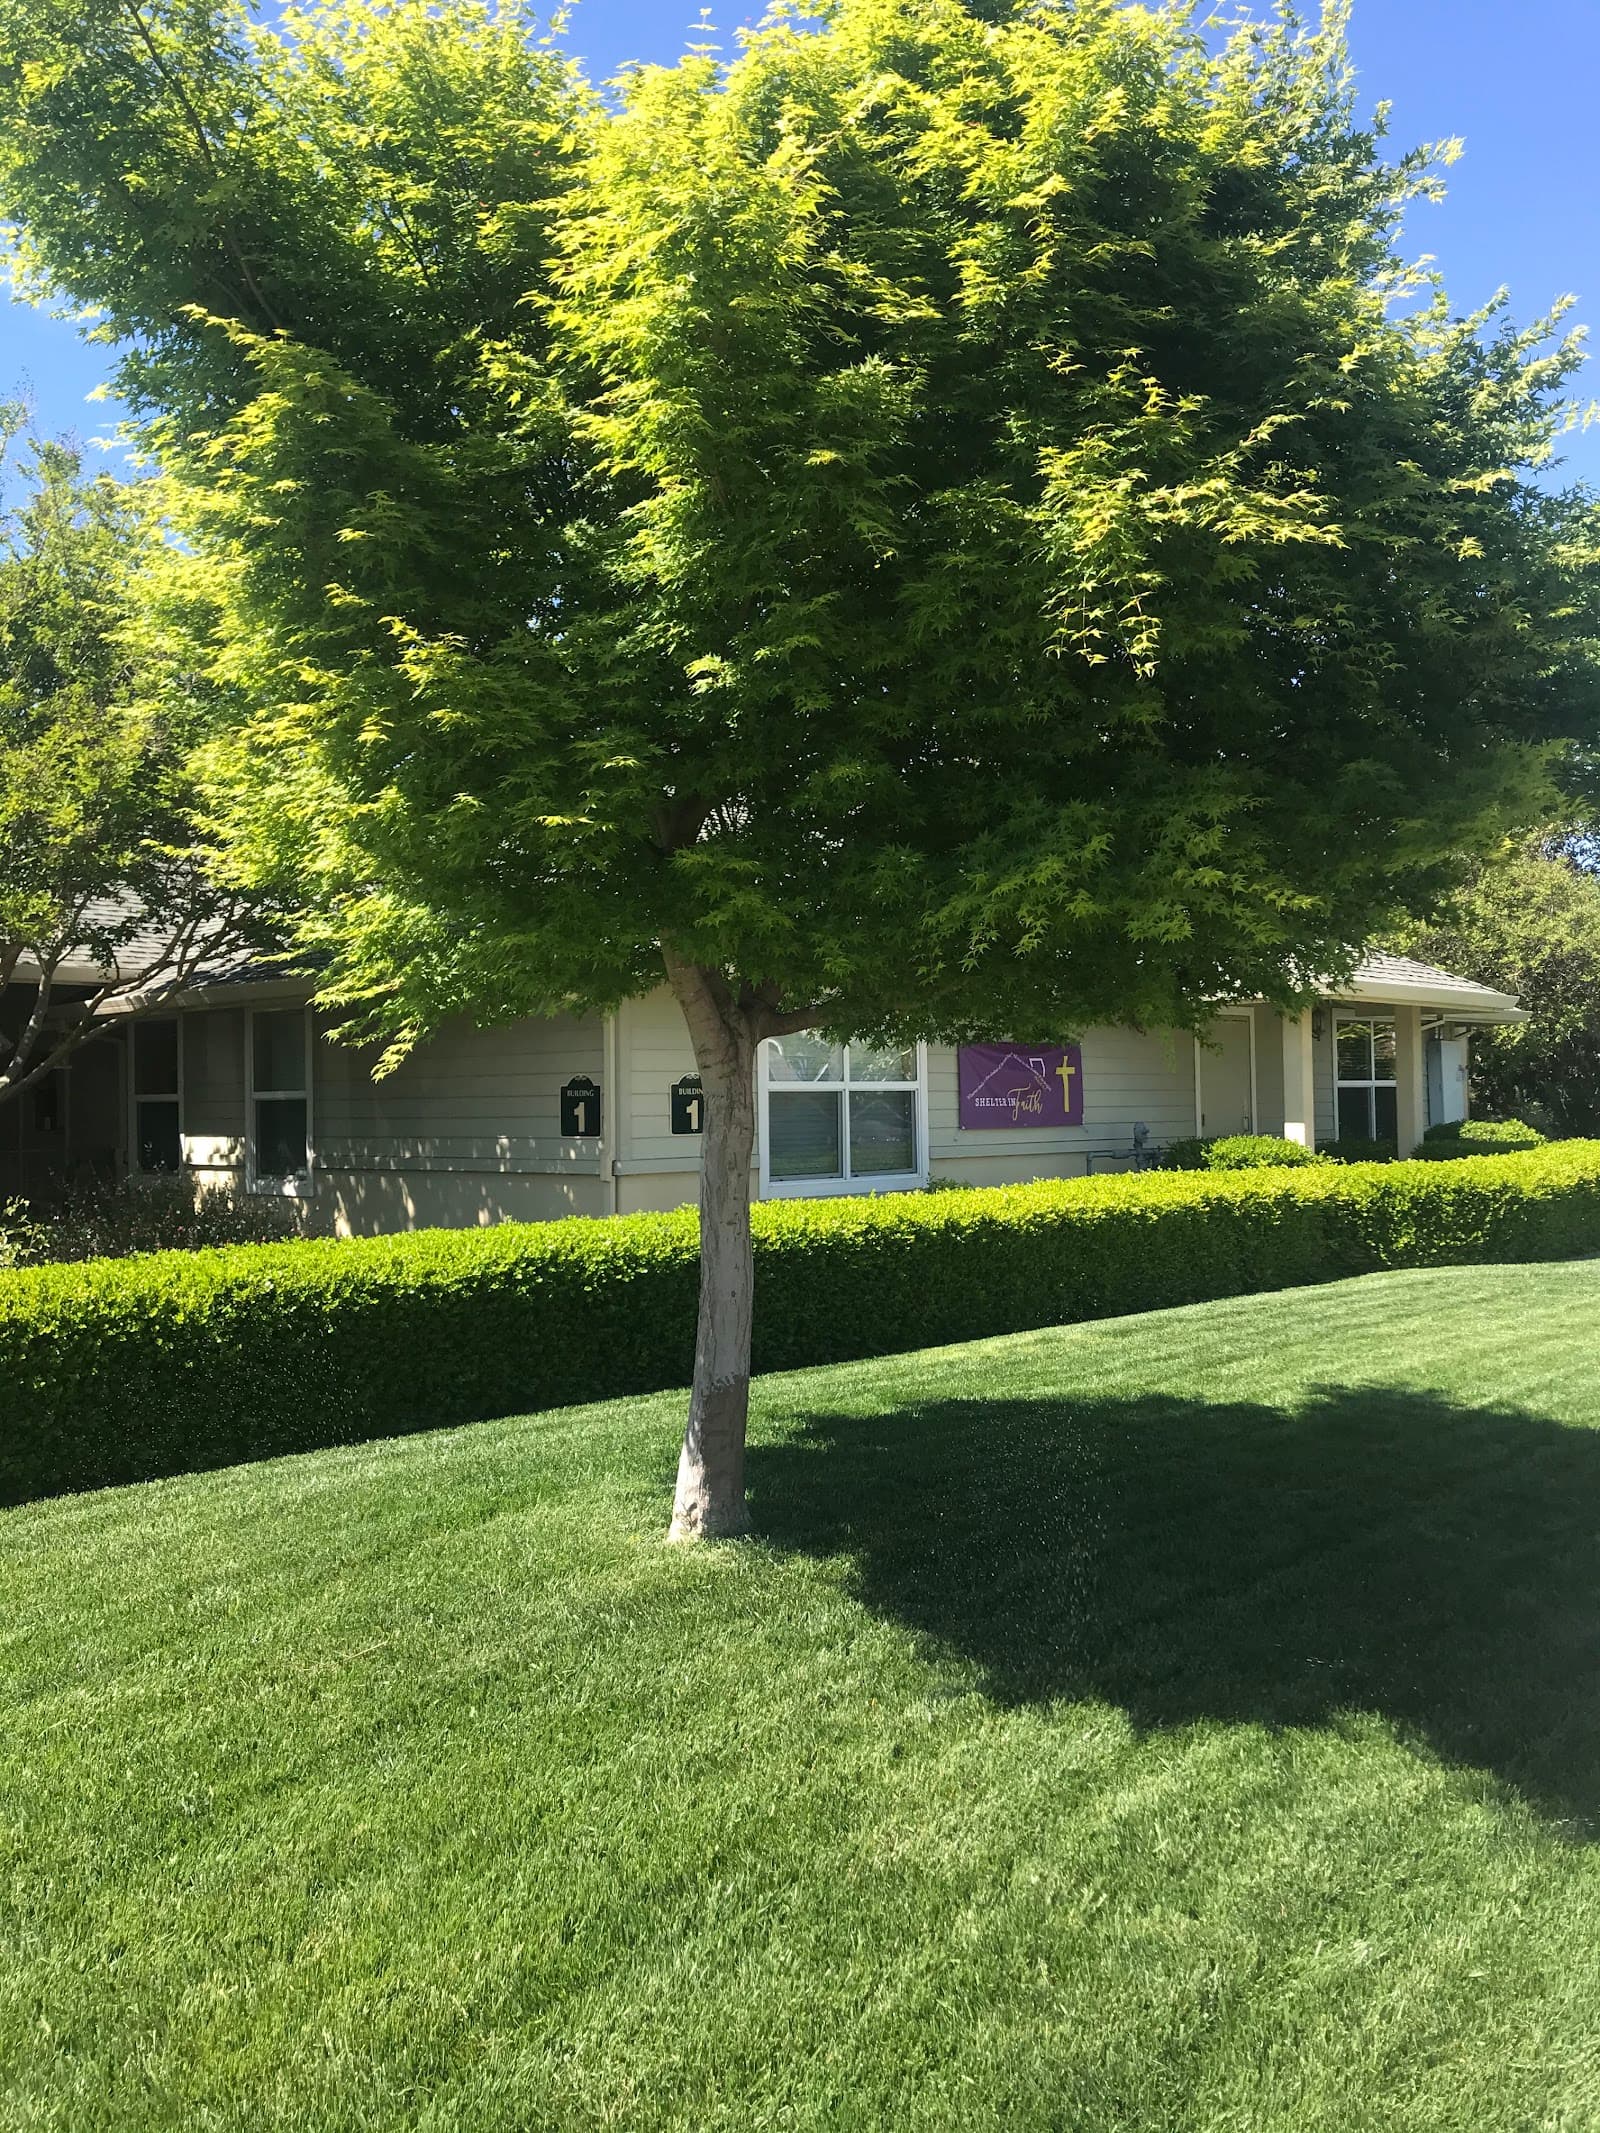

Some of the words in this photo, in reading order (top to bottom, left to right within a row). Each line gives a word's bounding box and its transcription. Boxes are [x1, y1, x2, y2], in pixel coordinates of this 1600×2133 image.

[567, 1089, 594, 1097] BUILDING
[678, 1087, 704, 1096] BUILDIN
[975, 1097, 1007, 1107] SHELTER
[1006, 1083, 1043, 1120] Faith
[1007, 1097, 1016, 1107] IN
[574, 1102, 585, 1132] 1
[686, 1099, 699, 1130] 1
